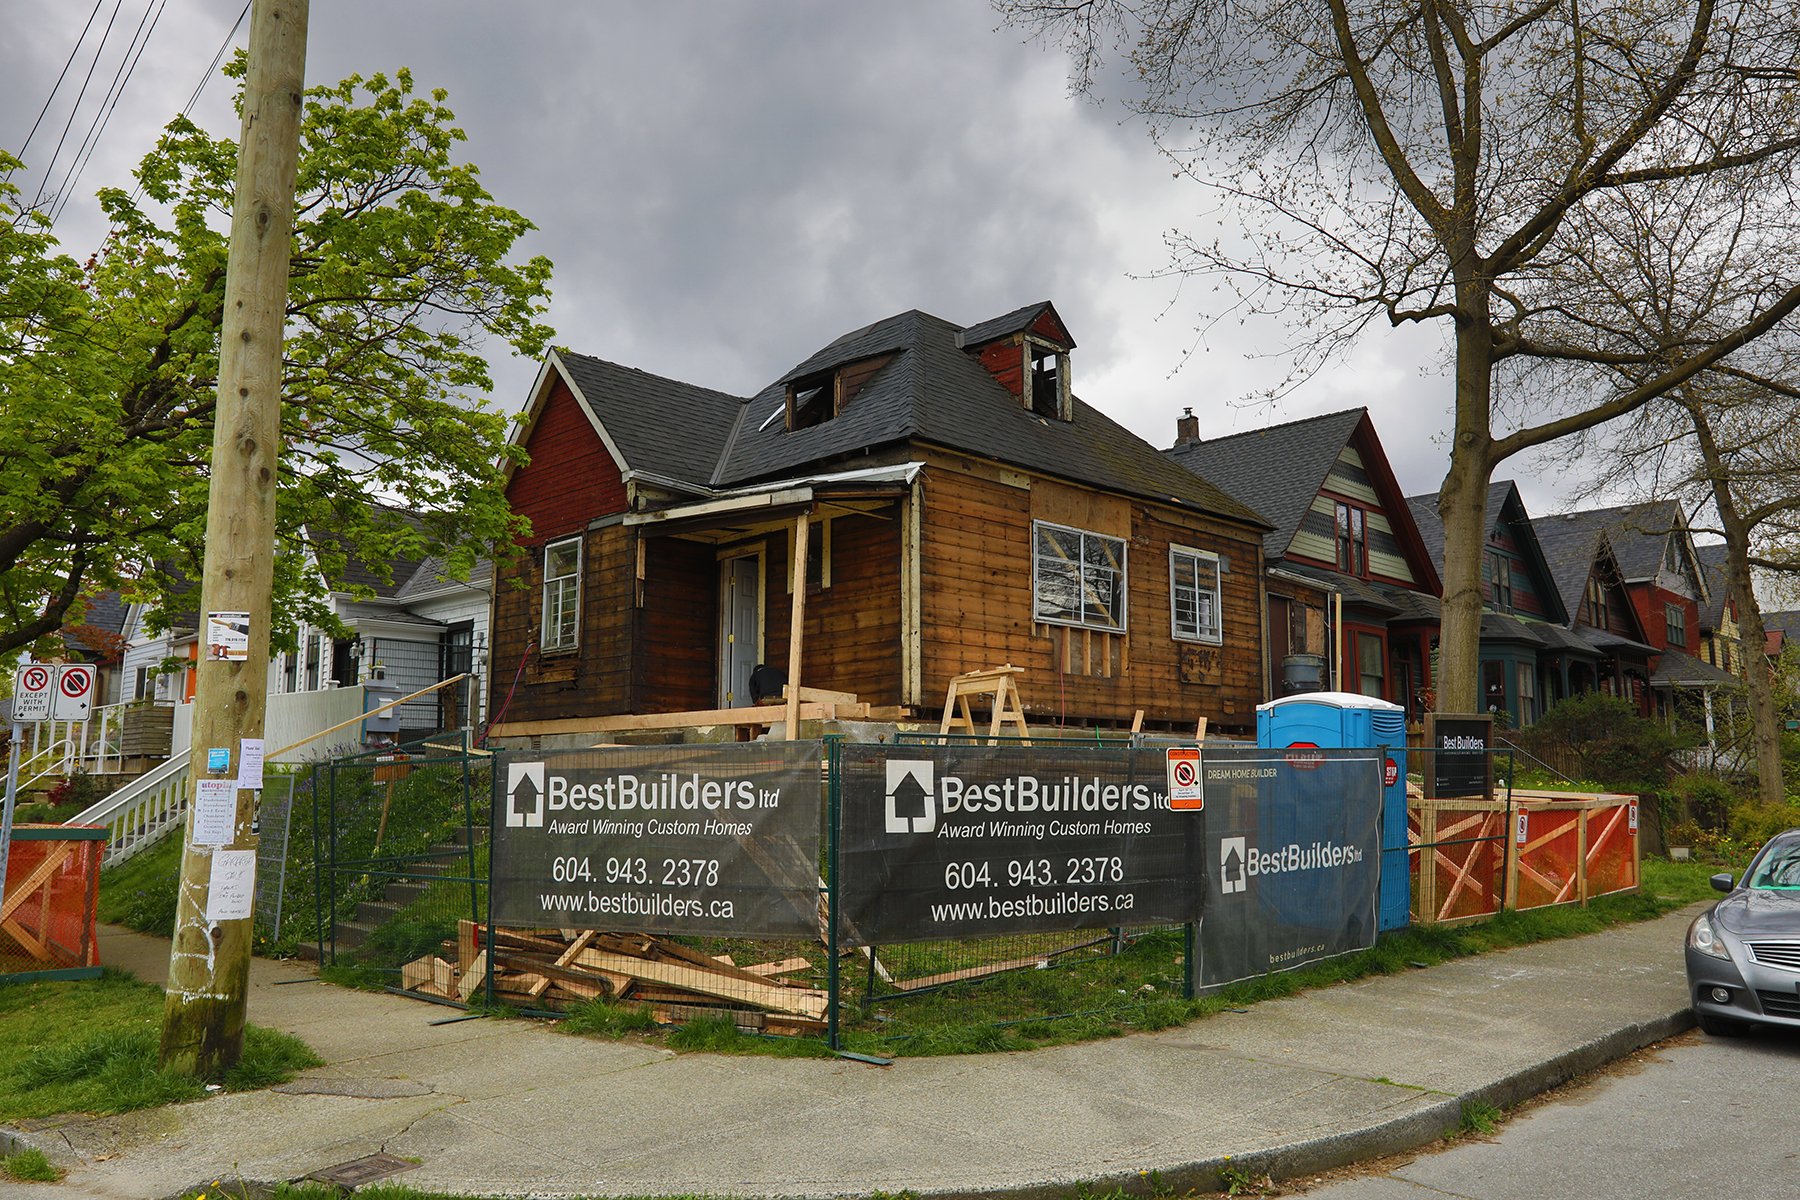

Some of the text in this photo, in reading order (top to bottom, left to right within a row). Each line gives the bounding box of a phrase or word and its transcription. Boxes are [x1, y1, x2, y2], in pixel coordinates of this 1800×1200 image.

[1207, 768, 1278, 780] DREAM HOME BUILDER
[549, 773, 780, 810] BestBuilders ltd
[941, 776, 1151, 813] BestBuilders
[548, 818, 753, 839] Award Winning Custom Homes
[937, 819, 1152, 840] Award Winning Custom Homes
[552, 856, 720, 886] 604. 943. 2378
[945, 856, 1124, 890] 604. 943. 2378
[1247, 841, 1355, 876] BestBuilders
[541, 890, 735, 919] www.bestbuilders.ca
[931, 892, 1134, 922] www.bestbuilders.ca
[1269, 943, 1325, 964] bestbuilders.ca
